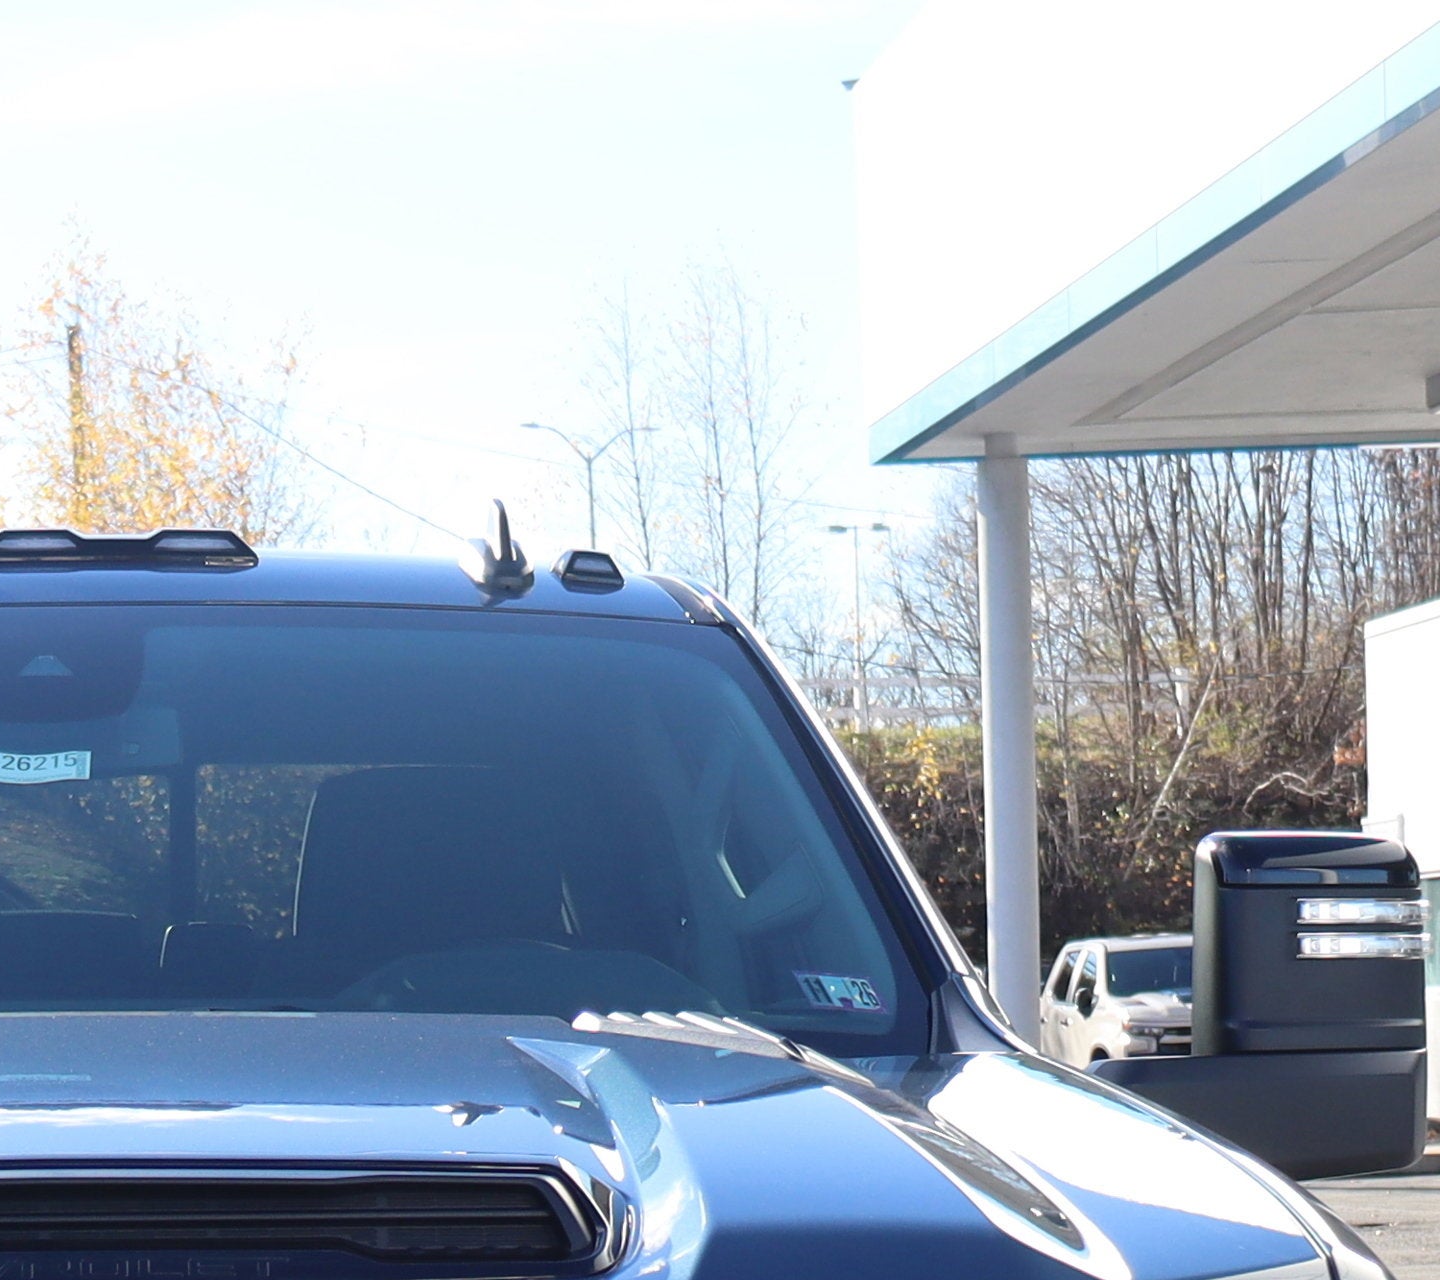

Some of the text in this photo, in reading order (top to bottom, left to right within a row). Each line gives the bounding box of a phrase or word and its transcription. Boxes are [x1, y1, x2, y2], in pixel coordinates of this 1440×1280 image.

[1, 753, 77, 772] 26215
[802, 977, 879, 1007] 11 26
